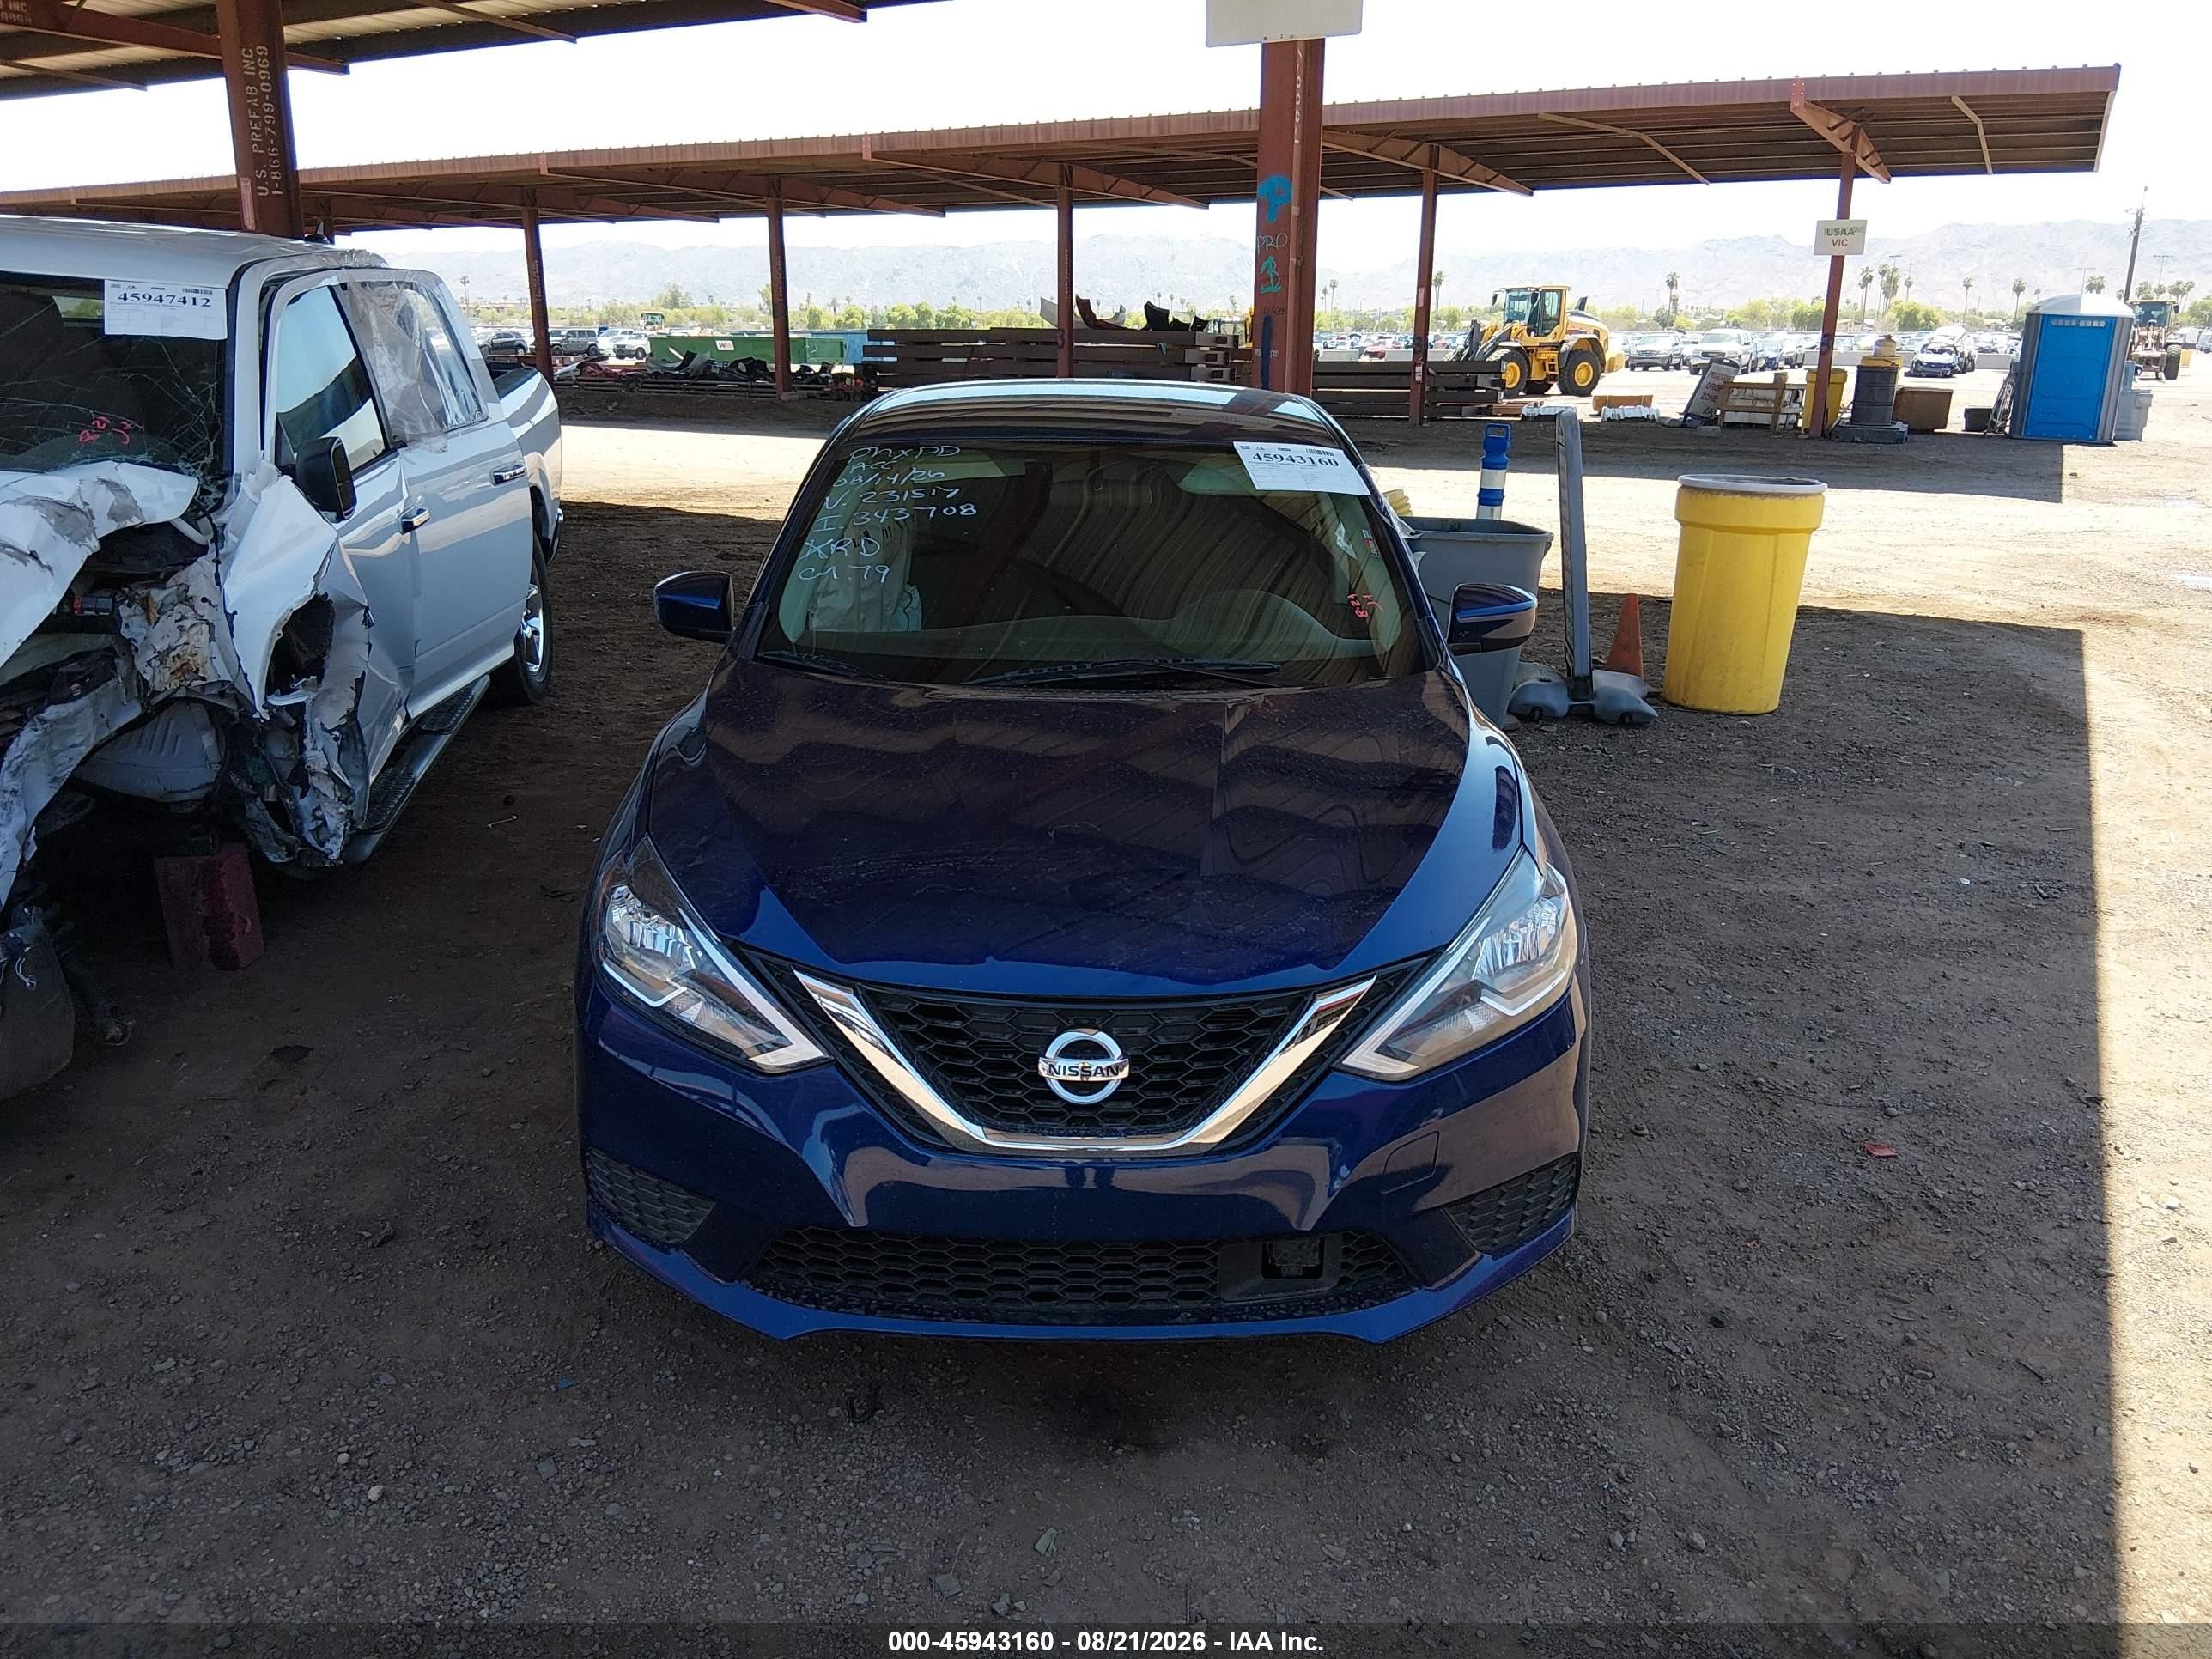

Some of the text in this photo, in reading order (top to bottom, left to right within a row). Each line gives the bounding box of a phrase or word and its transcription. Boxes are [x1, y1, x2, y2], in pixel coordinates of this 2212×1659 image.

[241, 48, 269, 196] U.S. PREFAB INC
[256, 45, 284, 195] 1-866-799-0969
[1826, 228, 1855, 236] USAA
[1257, 233, 1288, 255] PRO
[1832, 239, 1849, 247] VIC
[117, 292, 212, 307] 45947412
[1252, 453, 1340, 467] 45943160
[1048, 1063, 1120, 1077] NISSAN
